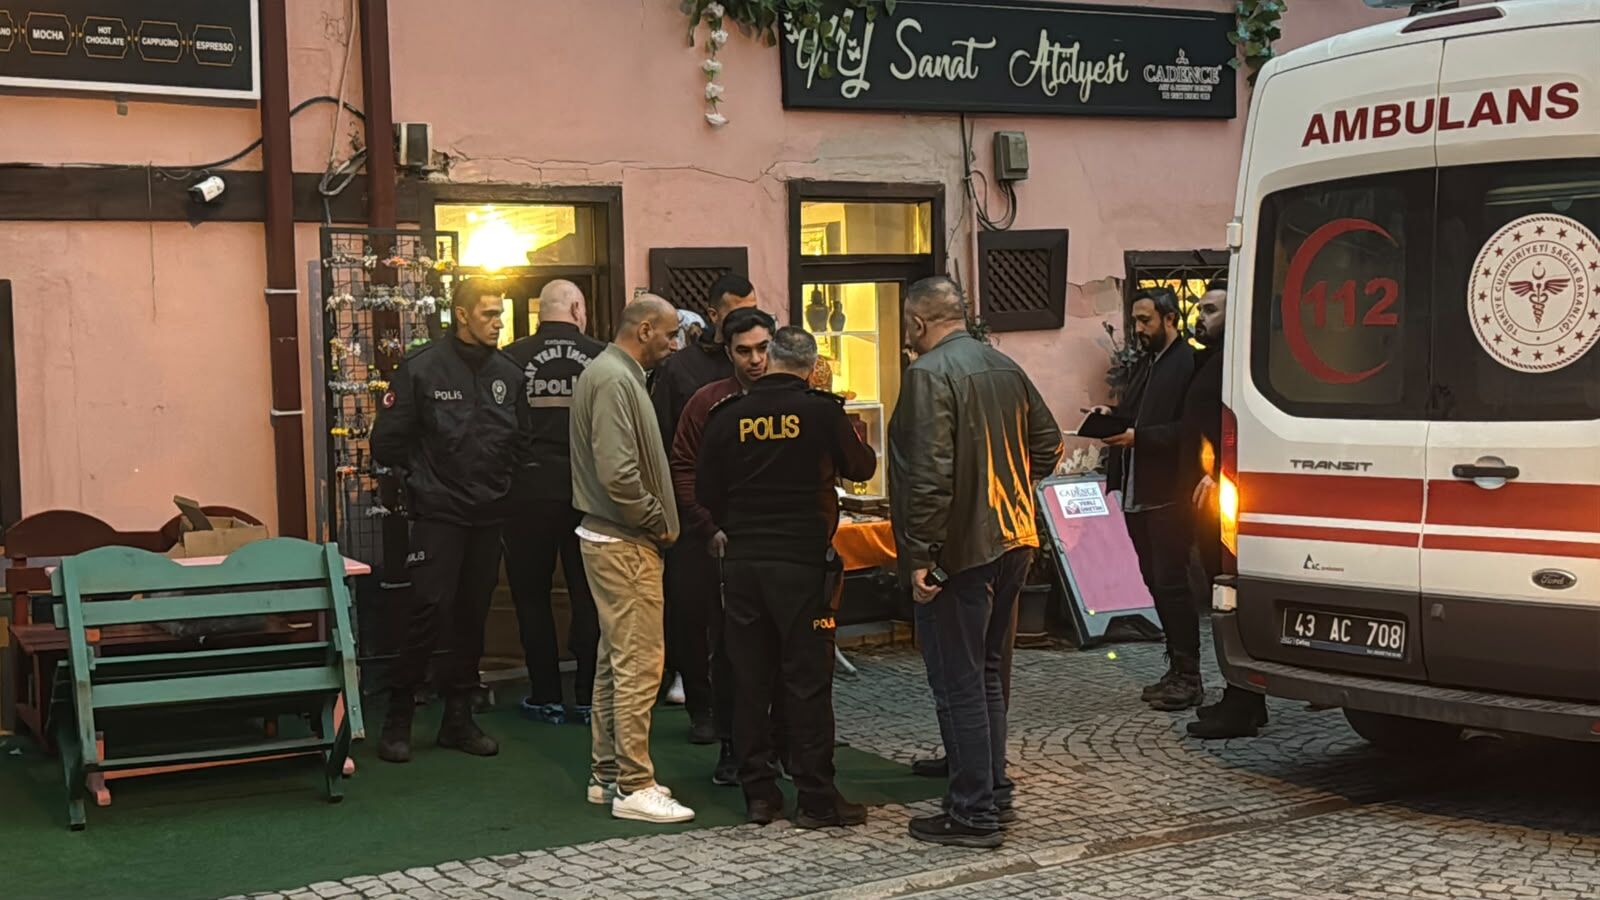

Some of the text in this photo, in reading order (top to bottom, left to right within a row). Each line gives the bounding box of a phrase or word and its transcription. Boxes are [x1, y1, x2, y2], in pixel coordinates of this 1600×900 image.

[32, 28, 65, 41] MOCHA
[97, 26, 112, 35] HOT
[85, 36, 125, 47] CHOCOLATE
[195, 40, 234, 52] ESPRESSO
[890, 18, 997, 81] Sanat
[1009, 29, 1129, 103] Atölyesi
[1143, 64, 1221, 84] CADENCE
[1301, 82, 1579, 147] AMBULANS
[1494, 244, 1549, 292] CUMHURİYETİ
[1303, 277, 1399, 328] 112
[1494, 296, 1519, 337] TÜRKİYE
[1290, 459, 1373, 472] TRANSIT
[1540, 574, 1566, 585] Ford
[1295, 613, 1401, 649] 43 AC 708
